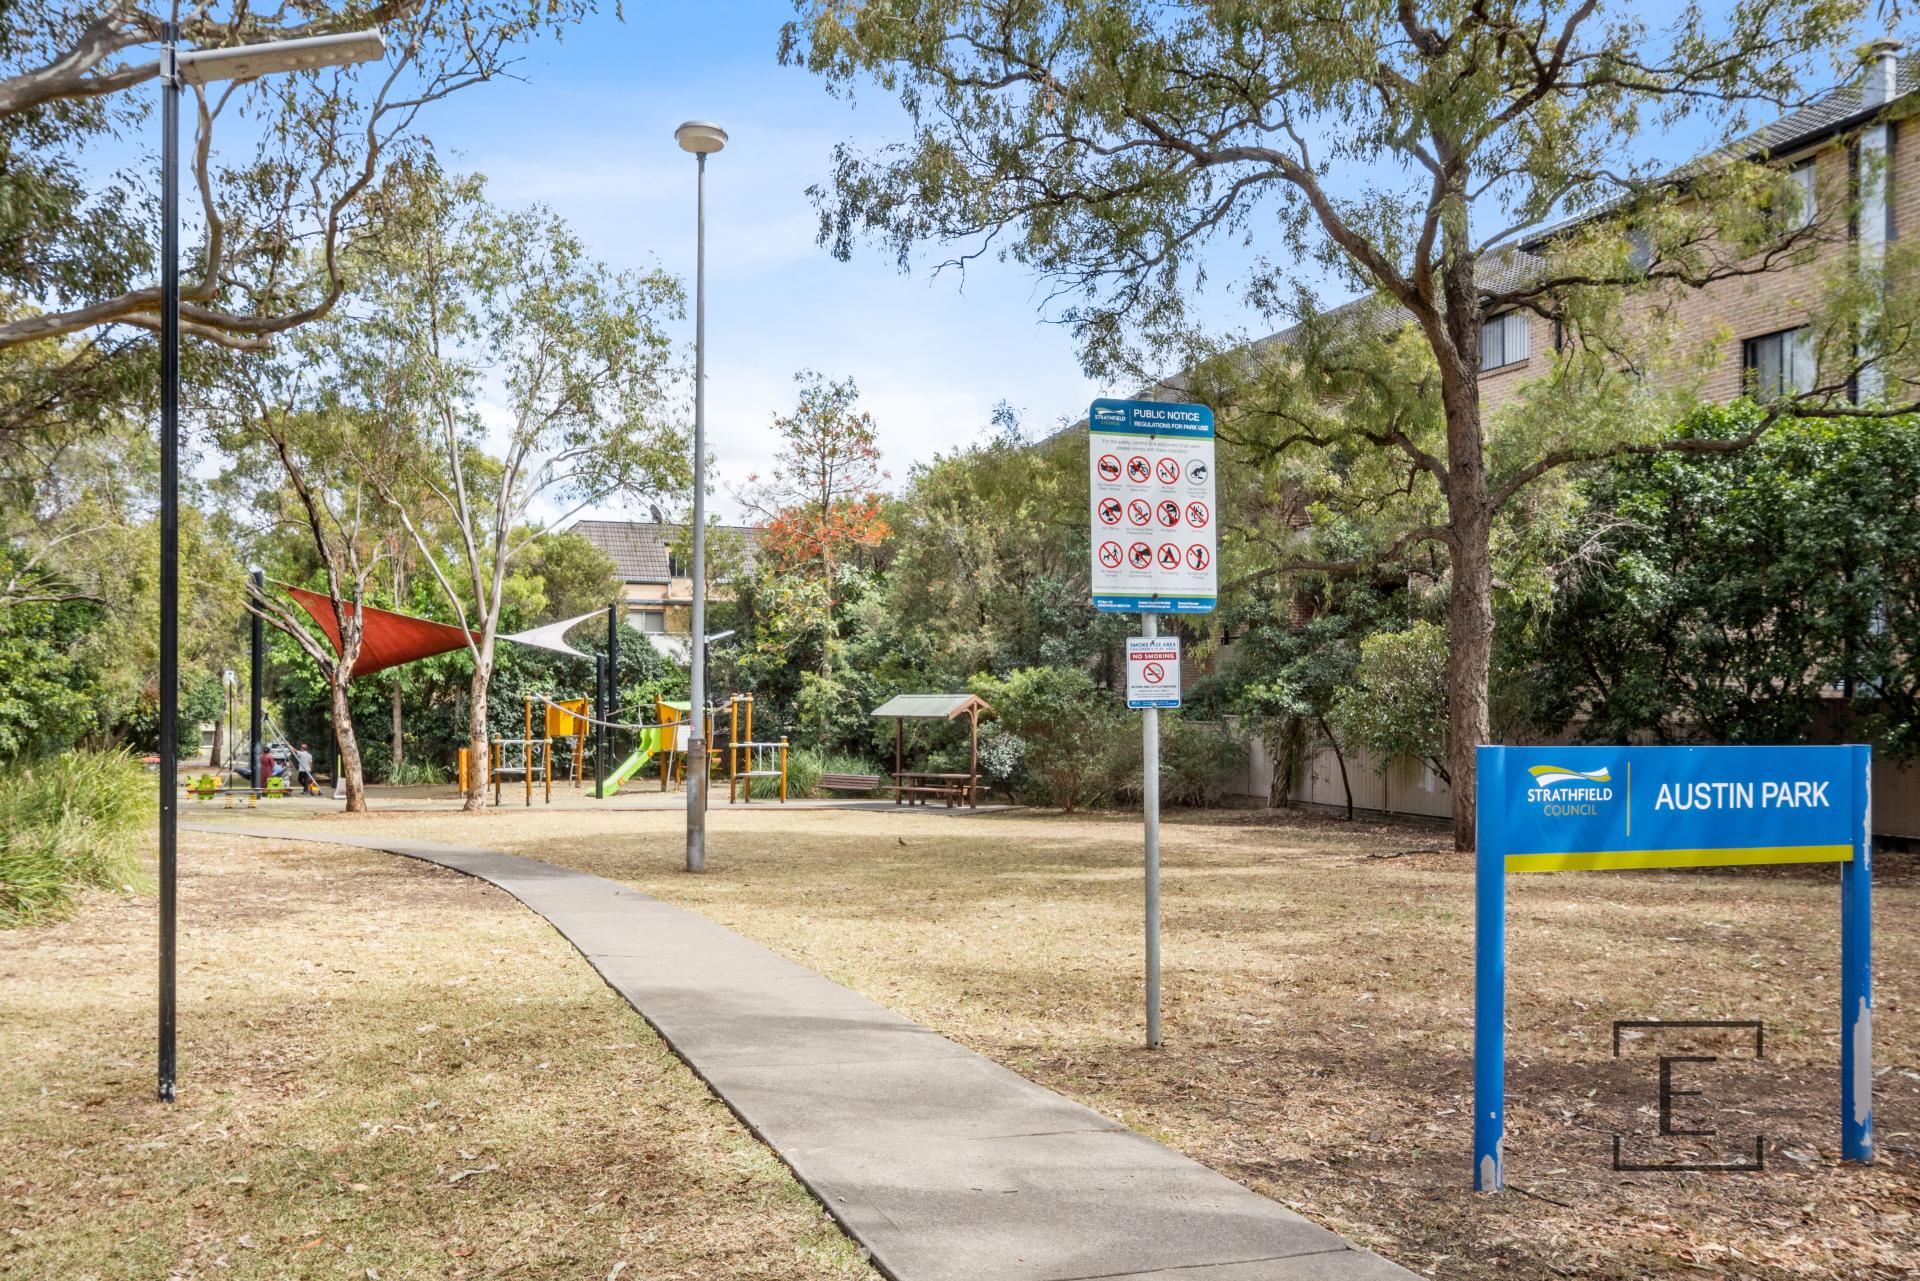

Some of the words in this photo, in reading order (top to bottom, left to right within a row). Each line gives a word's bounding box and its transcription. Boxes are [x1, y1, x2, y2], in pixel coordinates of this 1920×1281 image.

[1094, 414, 1126, 422] STRATHFIELD
[1133, 408, 1166, 419] PUBLIC
[1167, 412, 1200, 422] NOTICE
[1527, 787, 1612, 803] STRATHFIELD
[1655, 782, 1753, 811] AUSTIN
[1762, 780, 1830, 809] PARK
[1543, 804, 1598, 816] COUNCIL
